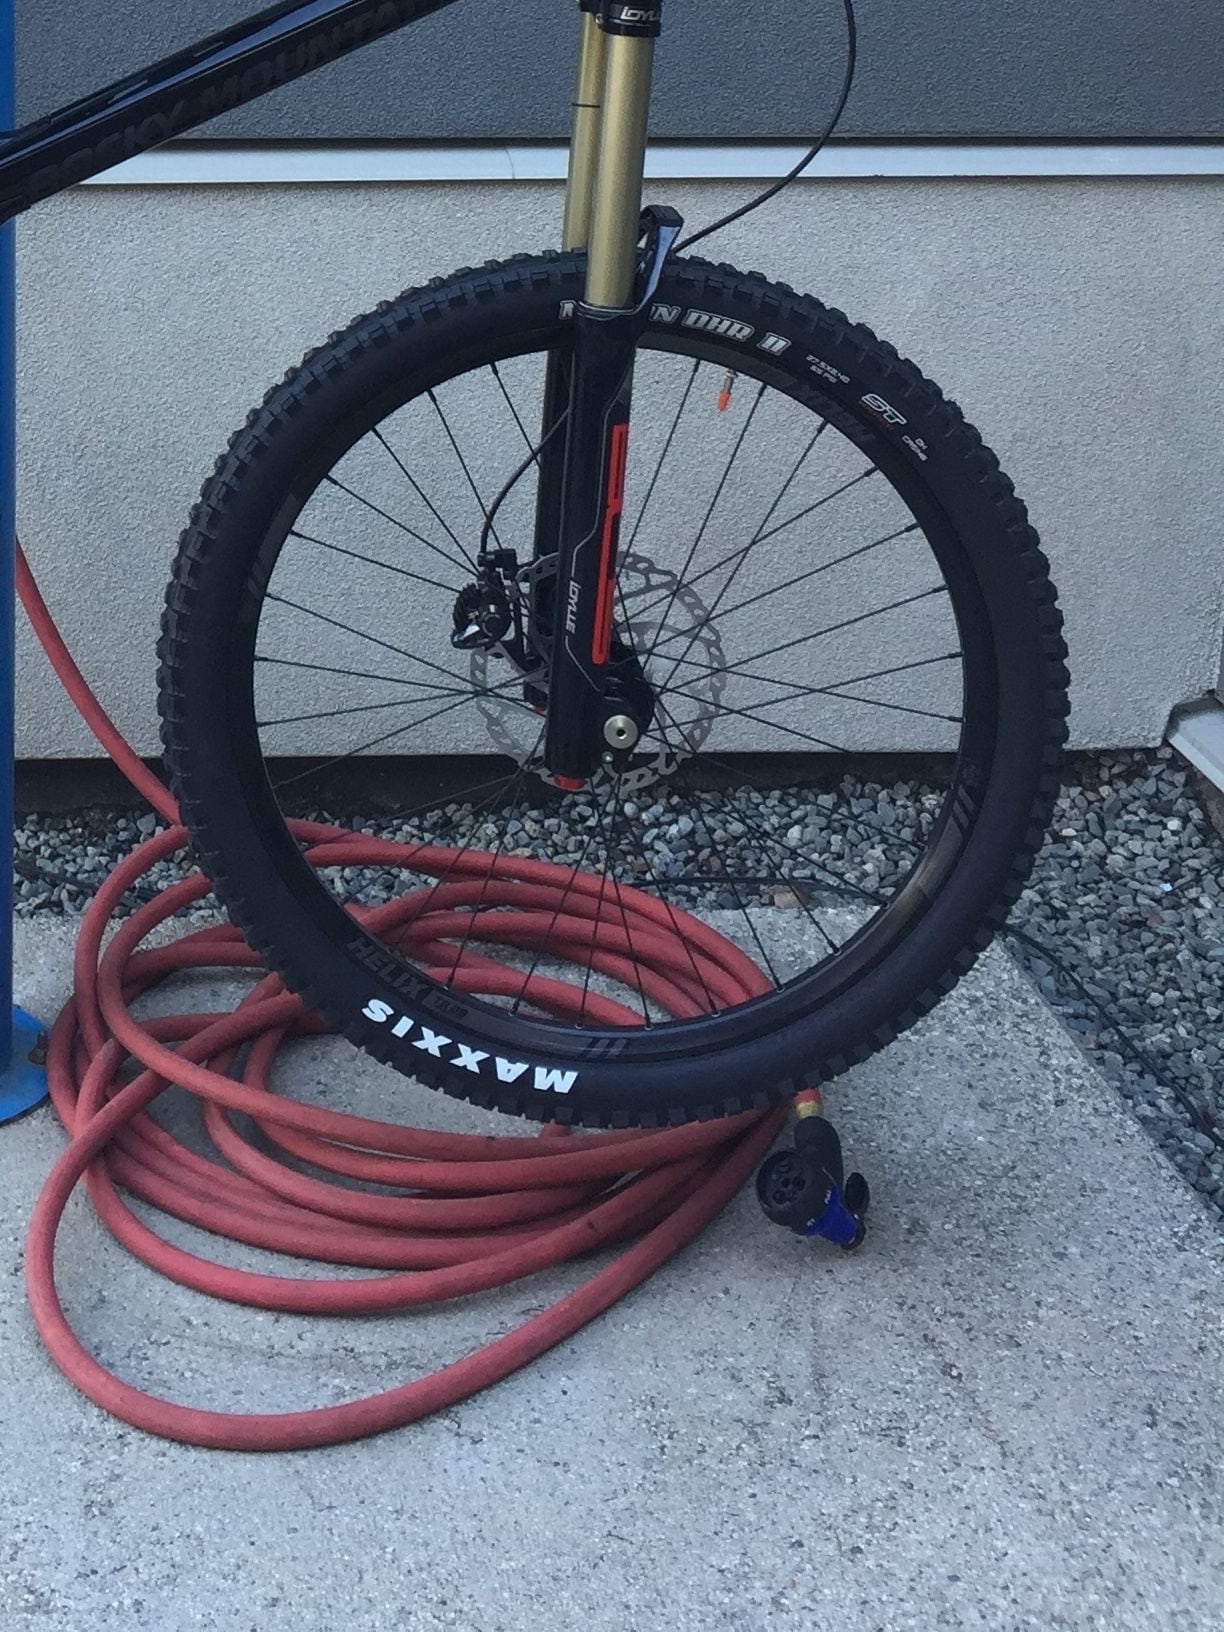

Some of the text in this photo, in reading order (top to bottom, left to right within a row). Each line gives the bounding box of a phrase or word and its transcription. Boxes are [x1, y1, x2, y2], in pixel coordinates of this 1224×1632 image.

[681, 309, 755, 342] DHR
[861, 393, 907, 425] ST
[361, 998, 579, 1094] MAXXIS
